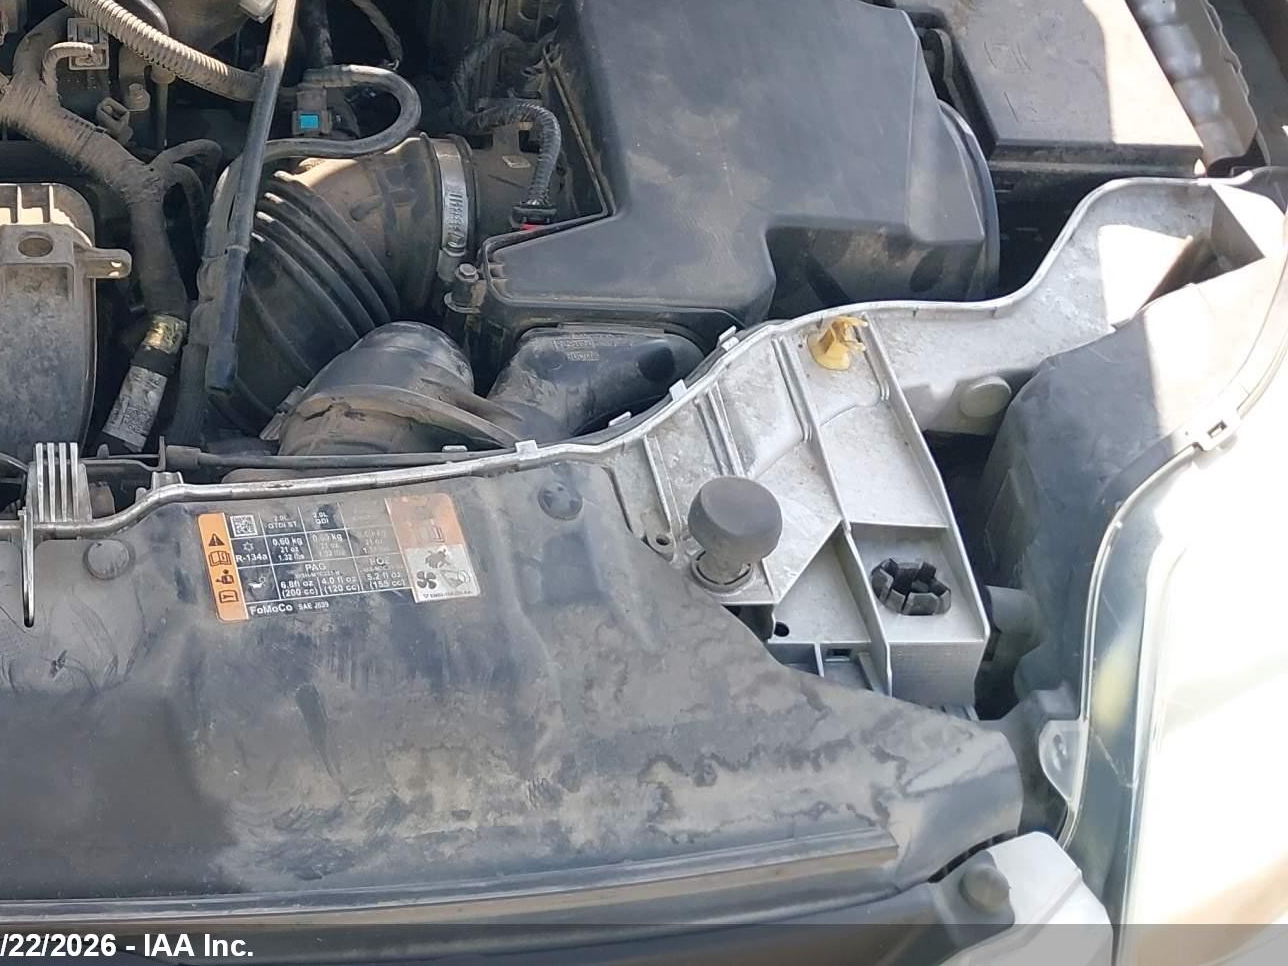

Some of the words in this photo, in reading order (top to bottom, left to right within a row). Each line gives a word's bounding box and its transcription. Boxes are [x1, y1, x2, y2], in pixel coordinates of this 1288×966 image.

[272, 537, 290, 546] 0.60
[292, 536, 304, 546] kg
[236, 553, 268, 563] R-134a
[304, 563, 327, 573] PAG
[282, 588, 301, 598] (200
[304, 587, 319, 596] cc)
[324, 584, 344, 595] (120
[250, 603, 293, 615] FoMoCo
[298, 601, 312, 611] SAE
